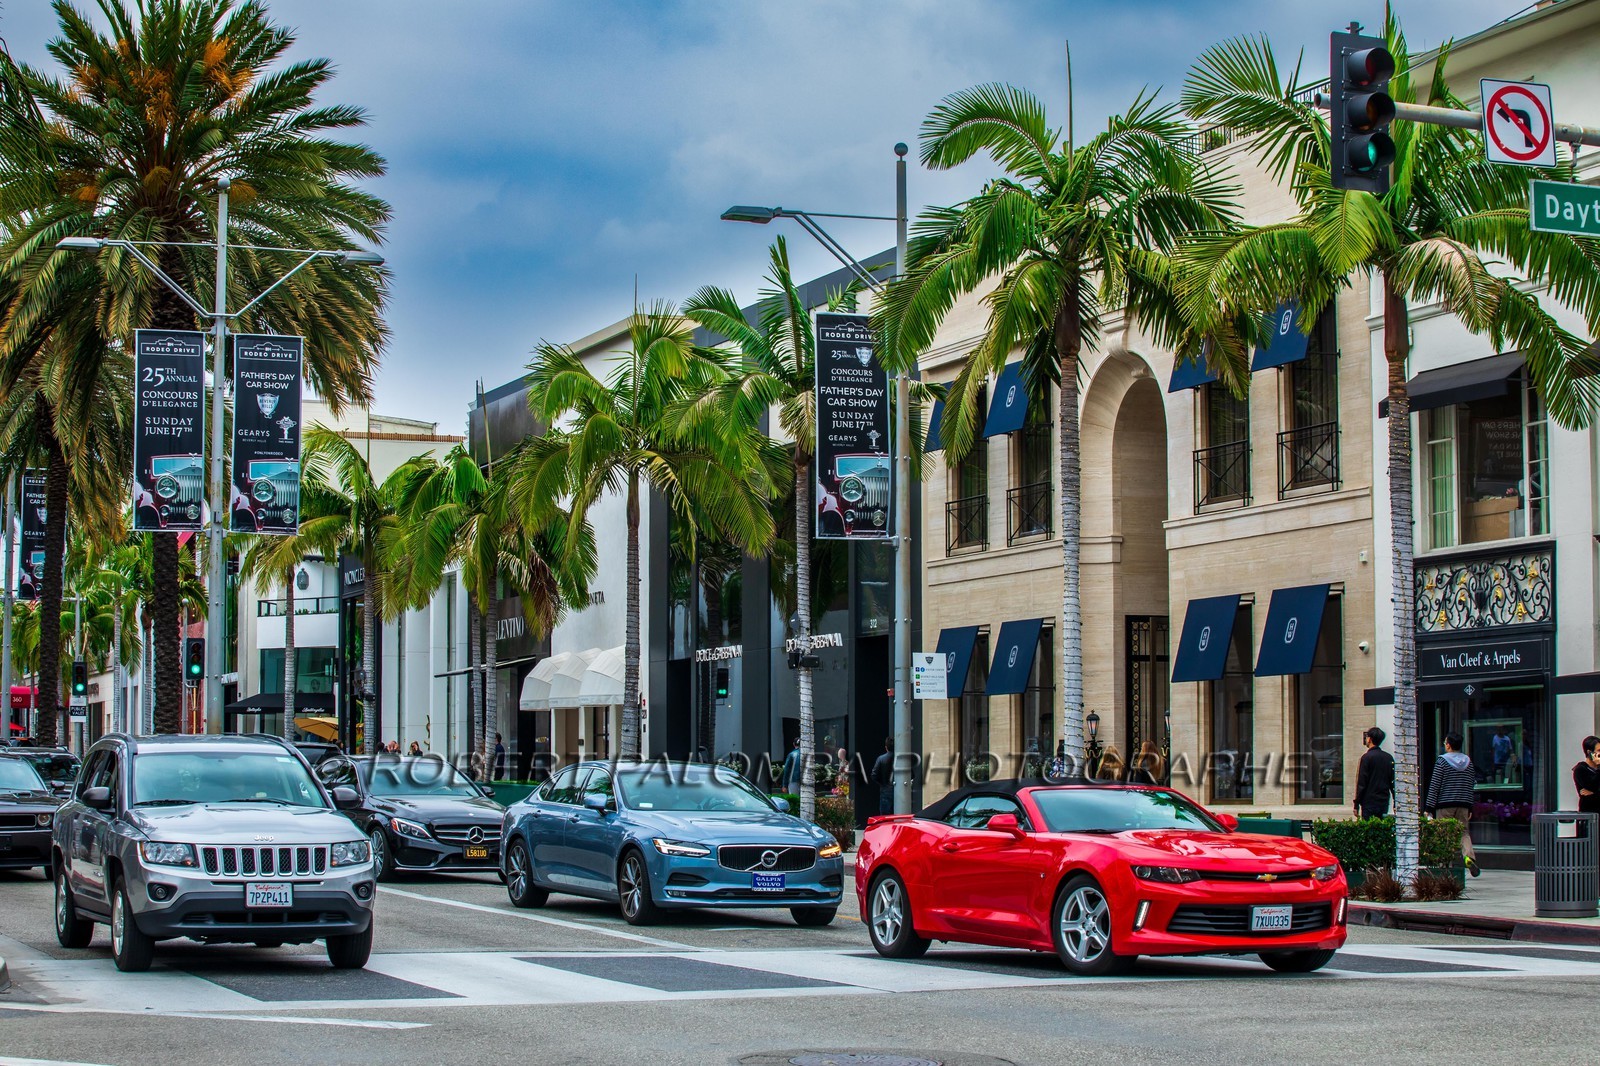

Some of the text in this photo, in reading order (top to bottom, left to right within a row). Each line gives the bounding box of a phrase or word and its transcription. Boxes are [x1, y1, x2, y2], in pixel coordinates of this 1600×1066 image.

[240, 371, 277, 380] FATHER'S
[831, 368, 873, 376] CONCOURS
[142, 390, 198, 399] CONCOURS
[820, 387, 863, 396] FATHER'S
[827, 398, 877, 407] CAR SHOW
[832, 411, 874, 419] SUNDAY
[145, 417, 193, 425] SUNDAY
[832, 421, 854, 429] JUNE
[145, 426, 170, 436] JUNE
[496, 616, 525, 640] LENTINO
[1441, 649, 1520, 669] Van Cleef & Arpels
[250, 892, 289, 903] 7PZP411
[1256, 915, 1290, 927] 7XUU335
